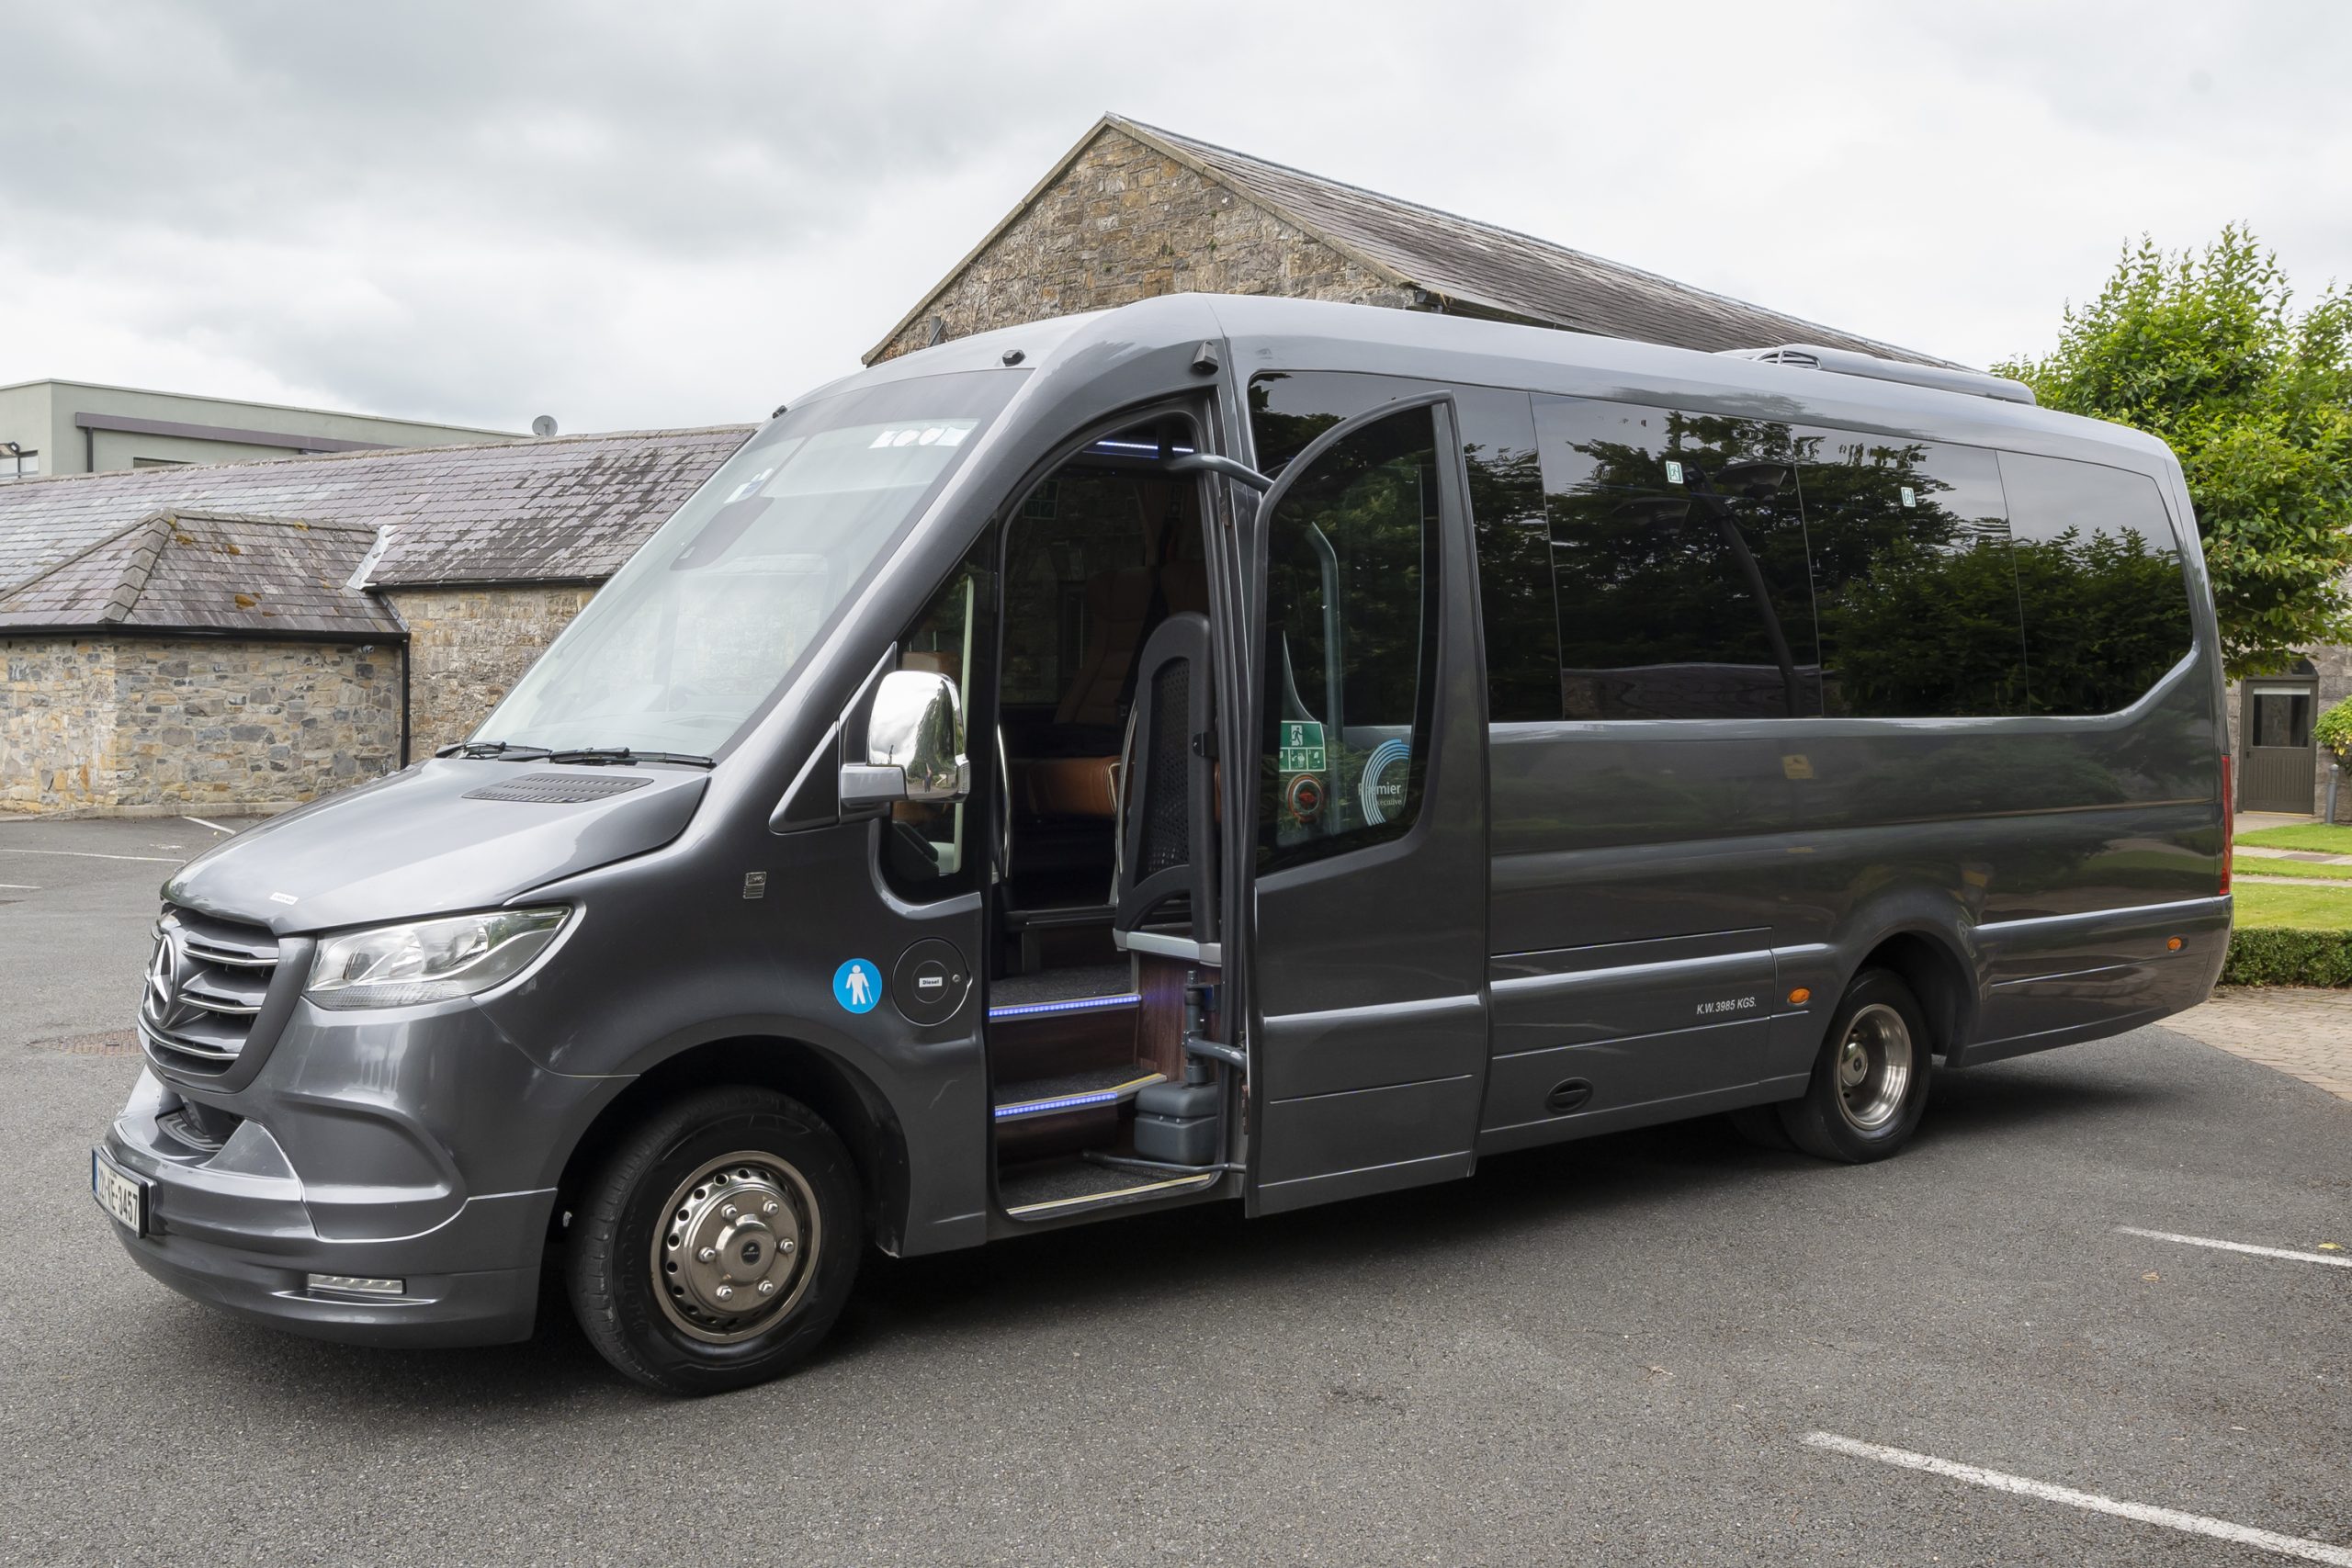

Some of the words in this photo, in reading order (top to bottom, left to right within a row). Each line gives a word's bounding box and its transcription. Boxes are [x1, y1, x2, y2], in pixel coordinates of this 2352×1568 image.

[1358, 782, 1401, 795] Pmier
[1715, 999, 1736, 1013] 3985
[1737, 997, 1757, 1010] KGS.
